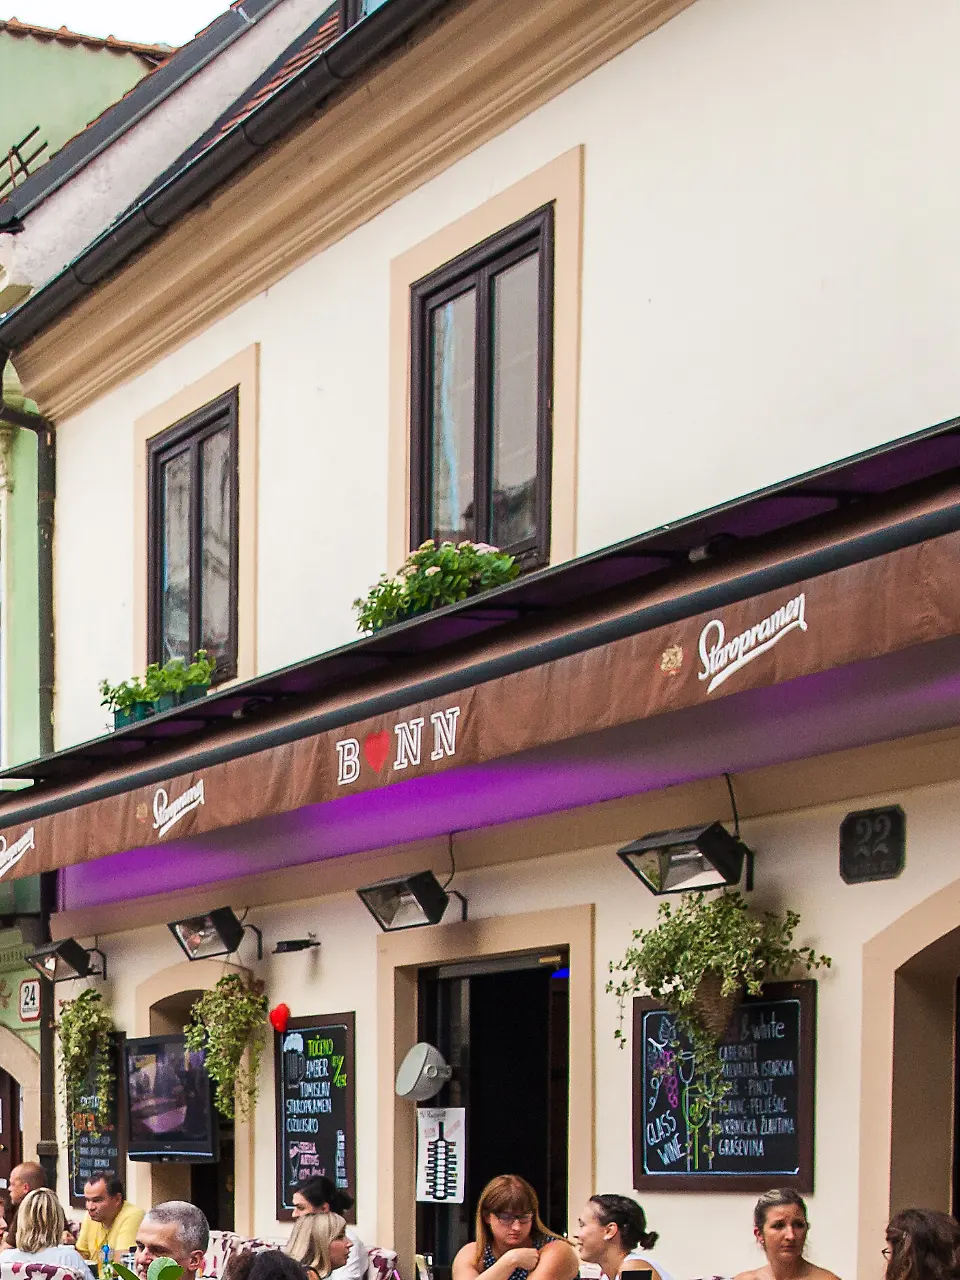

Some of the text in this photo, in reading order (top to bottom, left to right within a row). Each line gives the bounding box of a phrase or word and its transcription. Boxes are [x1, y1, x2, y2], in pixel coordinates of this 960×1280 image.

[698, 593, 808, 694] Staropramen
[336, 706, 460, 785] BNN
[23, 984, 37, 1006] 24
[751, 1012, 786, 1041] white
[306, 1058, 329, 1079] AMBER
[300, 1081, 331, 1098] TOMISLAV
[286, 1098, 332, 1115] STAROPRAMEN
